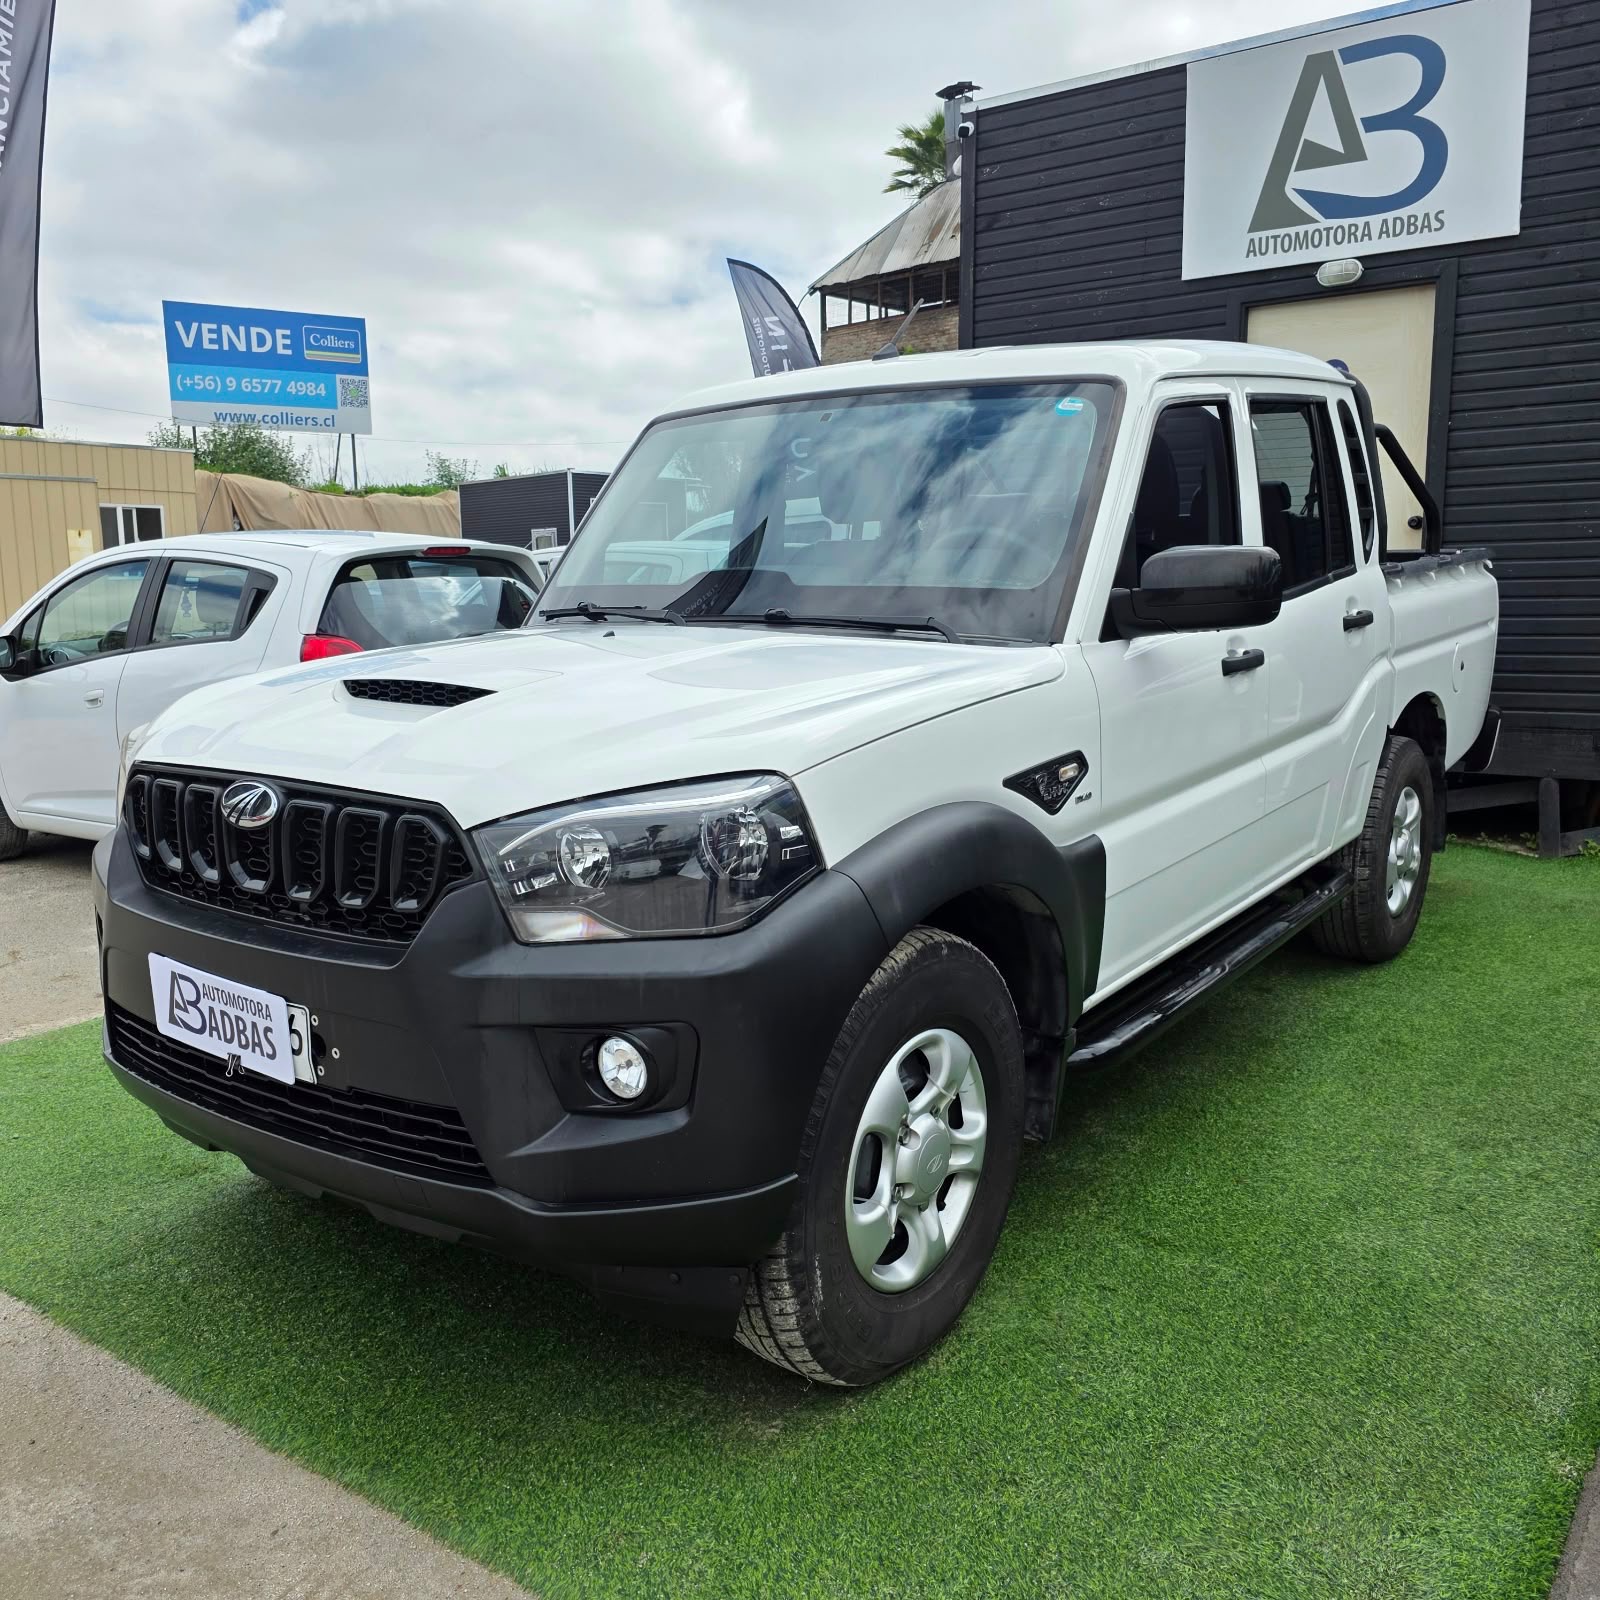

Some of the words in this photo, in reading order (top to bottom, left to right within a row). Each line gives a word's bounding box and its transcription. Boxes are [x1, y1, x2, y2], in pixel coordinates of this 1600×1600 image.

[1246, 221, 1372, 258] AUTOMOTORA
[1377, 209, 1445, 241] ADBAS
[174, 320, 293, 355] VENDE
[309, 333, 355, 349] Colliers
[176, 374, 222, 393] (+56)
[226, 377, 236, 391] 9
[241, 378, 282, 394] 6577
[286, 381, 326, 397] 4984
[214, 411, 335, 428] www.colliers.cl
[202, 983, 273, 1022] AUTOMOTORA
[208, 1006, 277, 1060] ADBAS
